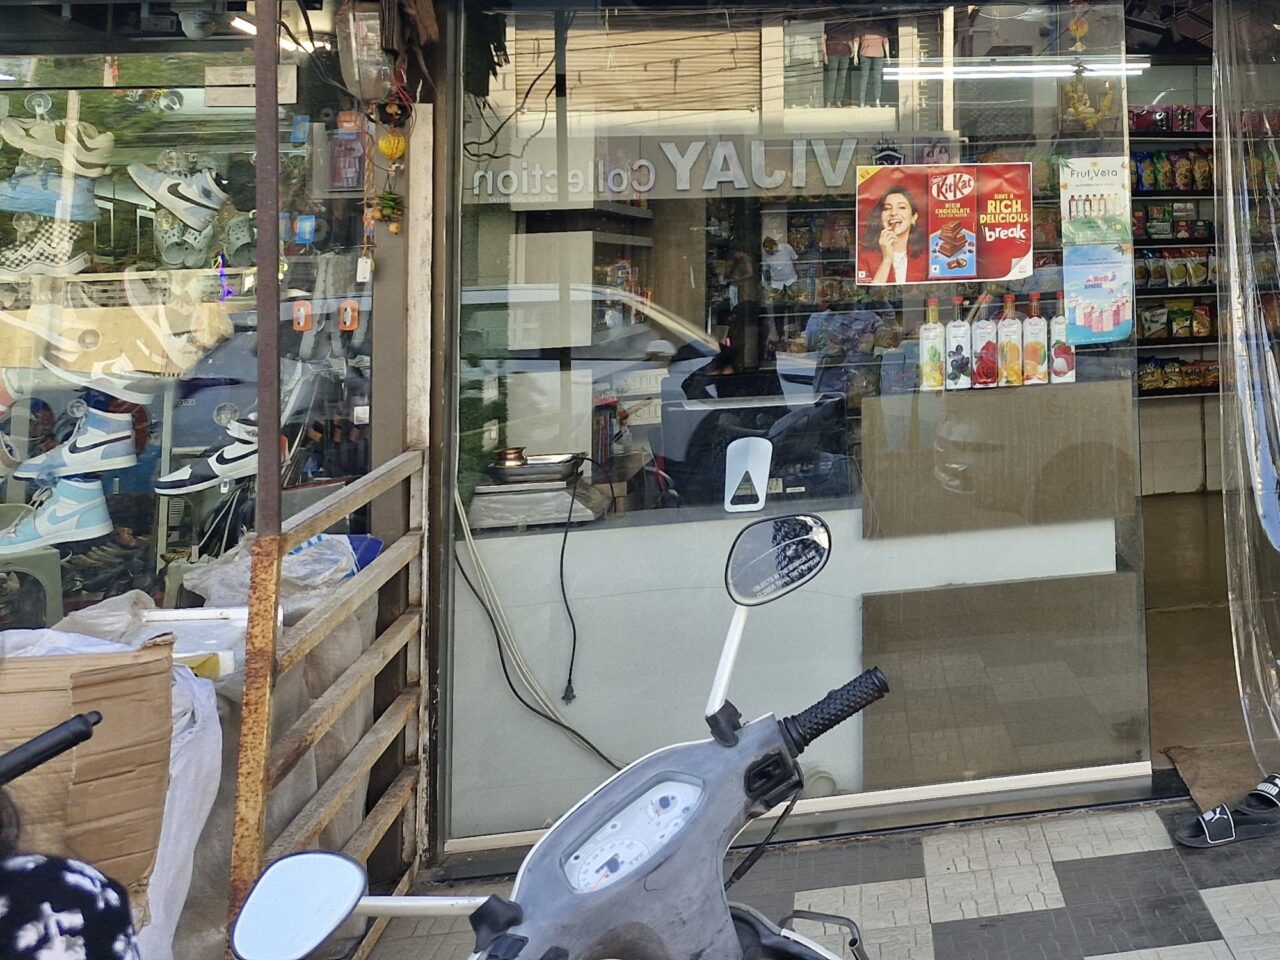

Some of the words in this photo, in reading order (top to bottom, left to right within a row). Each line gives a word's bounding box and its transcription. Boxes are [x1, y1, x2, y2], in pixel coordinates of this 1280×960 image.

[935, 173, 974, 200] KitKat
[987, 200, 1022, 214] RICH
[980, 213, 1029, 224] DELICIOUS
[985, 224, 1027, 242] break
